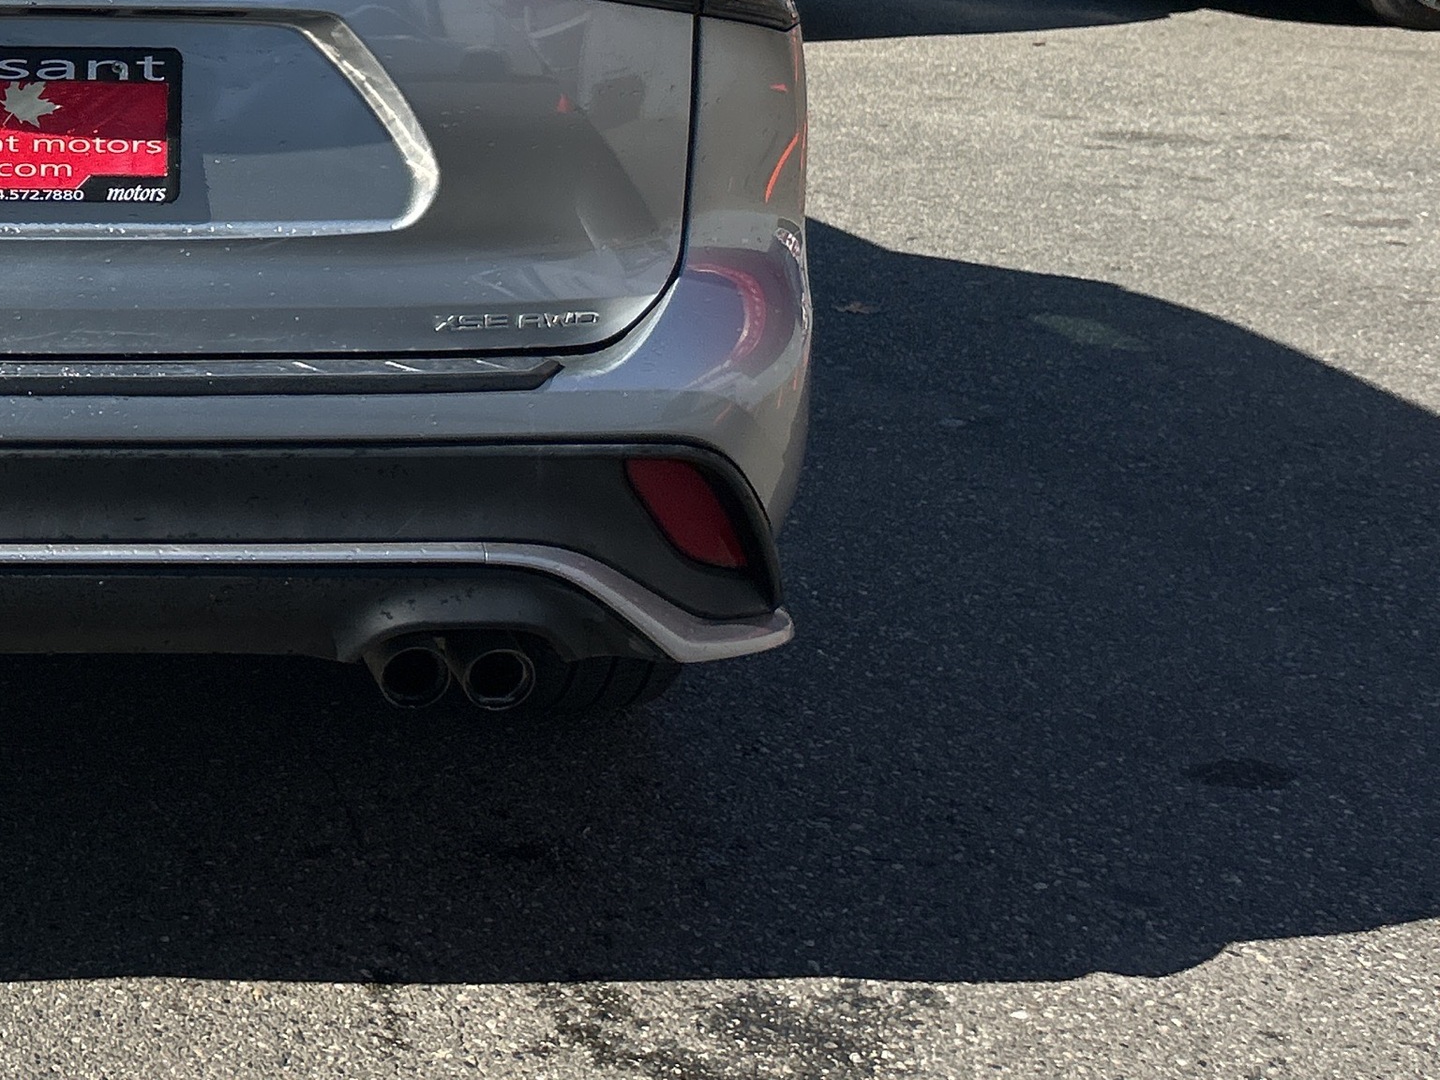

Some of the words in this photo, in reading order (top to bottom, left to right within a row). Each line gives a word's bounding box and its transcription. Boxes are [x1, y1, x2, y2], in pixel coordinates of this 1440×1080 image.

[33, 137, 163, 155] motors
[106, 184, 168, 203] motors
[435, 313, 509, 331] XSE
[518, 310, 600, 330] AWD
